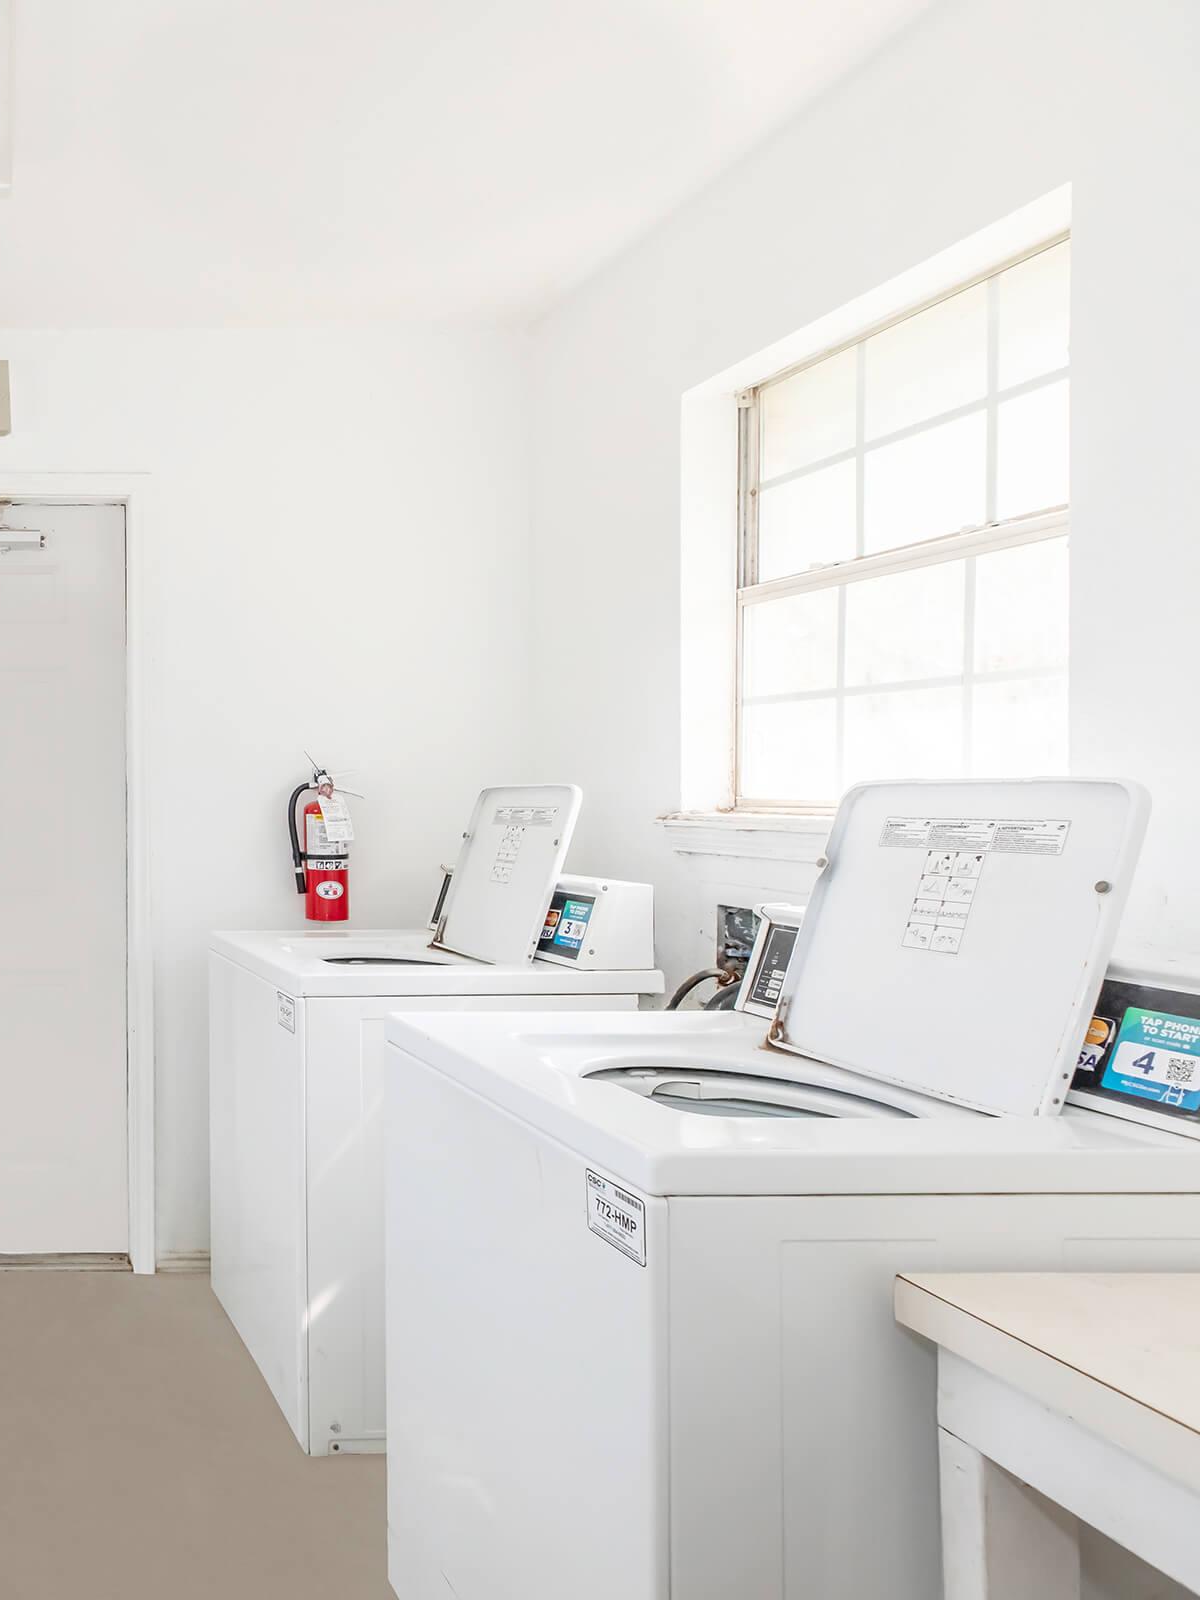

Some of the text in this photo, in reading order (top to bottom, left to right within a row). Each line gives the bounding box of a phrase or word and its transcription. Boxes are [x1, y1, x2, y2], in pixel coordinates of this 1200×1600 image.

[564, 922, 572, 934] 3
[1141, 1015, 1165, 1027] TAP
[1143, 1025, 1200, 1043] TO START
[1077, 1051, 1097, 1068] SA
[1132, 1051, 1156, 1075] 4
[596, 1198, 637, 1233] 772-HMP
